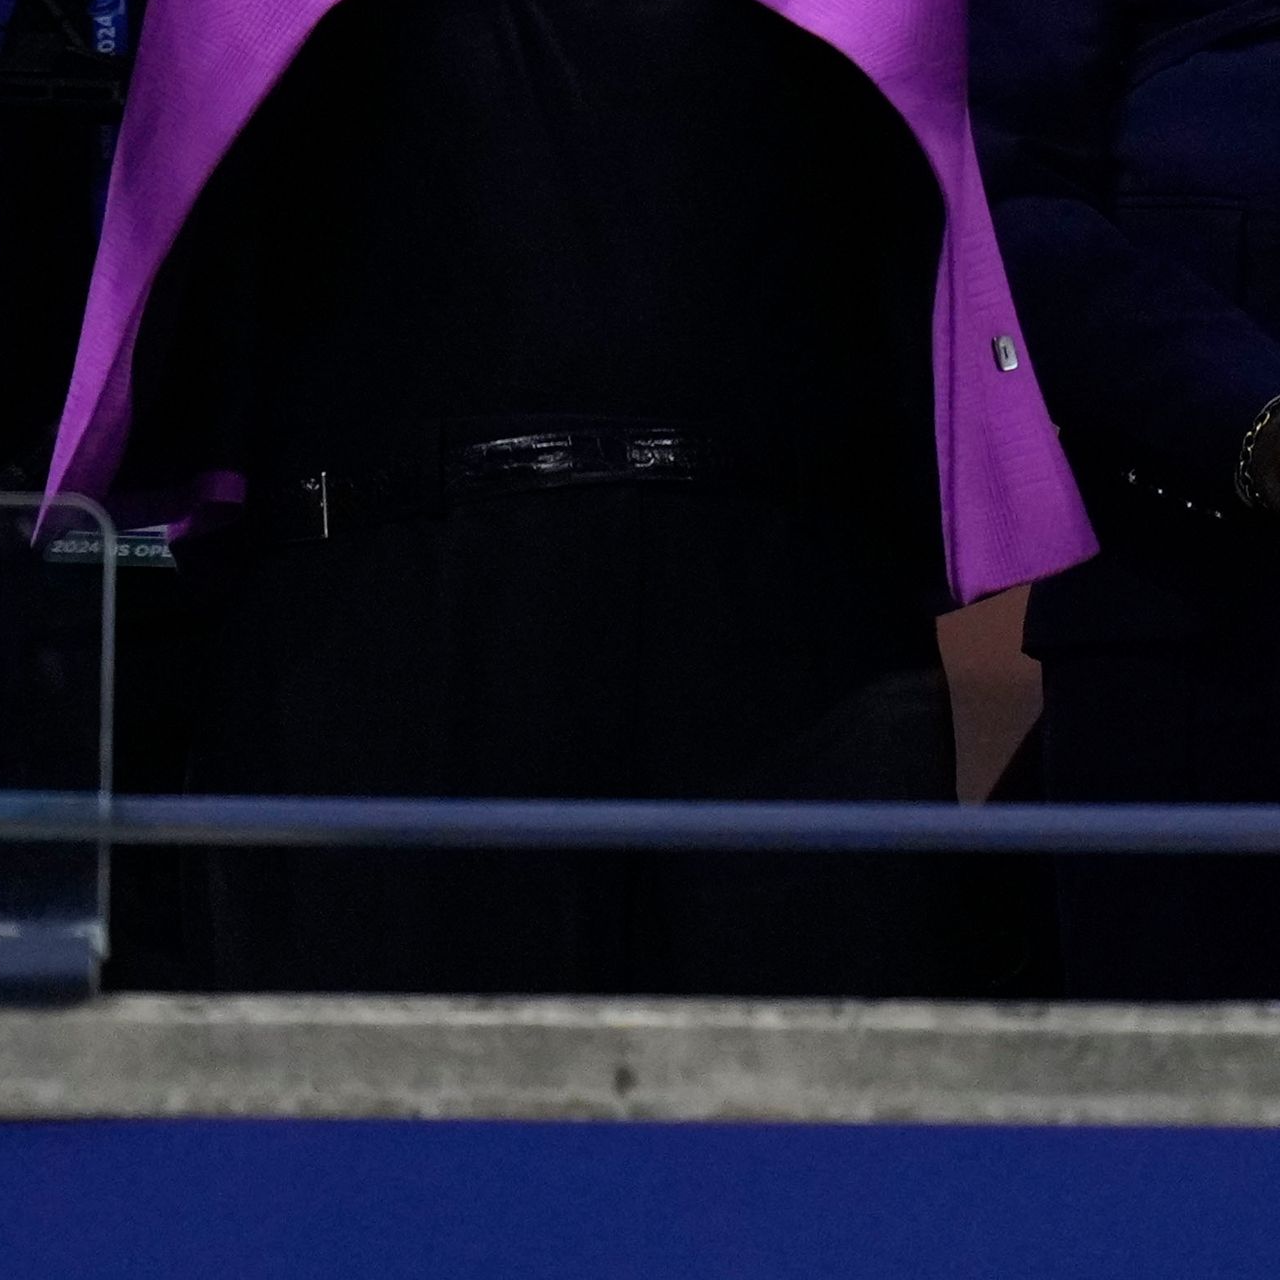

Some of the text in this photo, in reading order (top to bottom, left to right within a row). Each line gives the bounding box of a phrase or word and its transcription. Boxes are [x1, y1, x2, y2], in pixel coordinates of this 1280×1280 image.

[91, 14, 116, 55] 024
[50, 540, 100, 553] 2024
[135, 544, 172, 557] OPE
